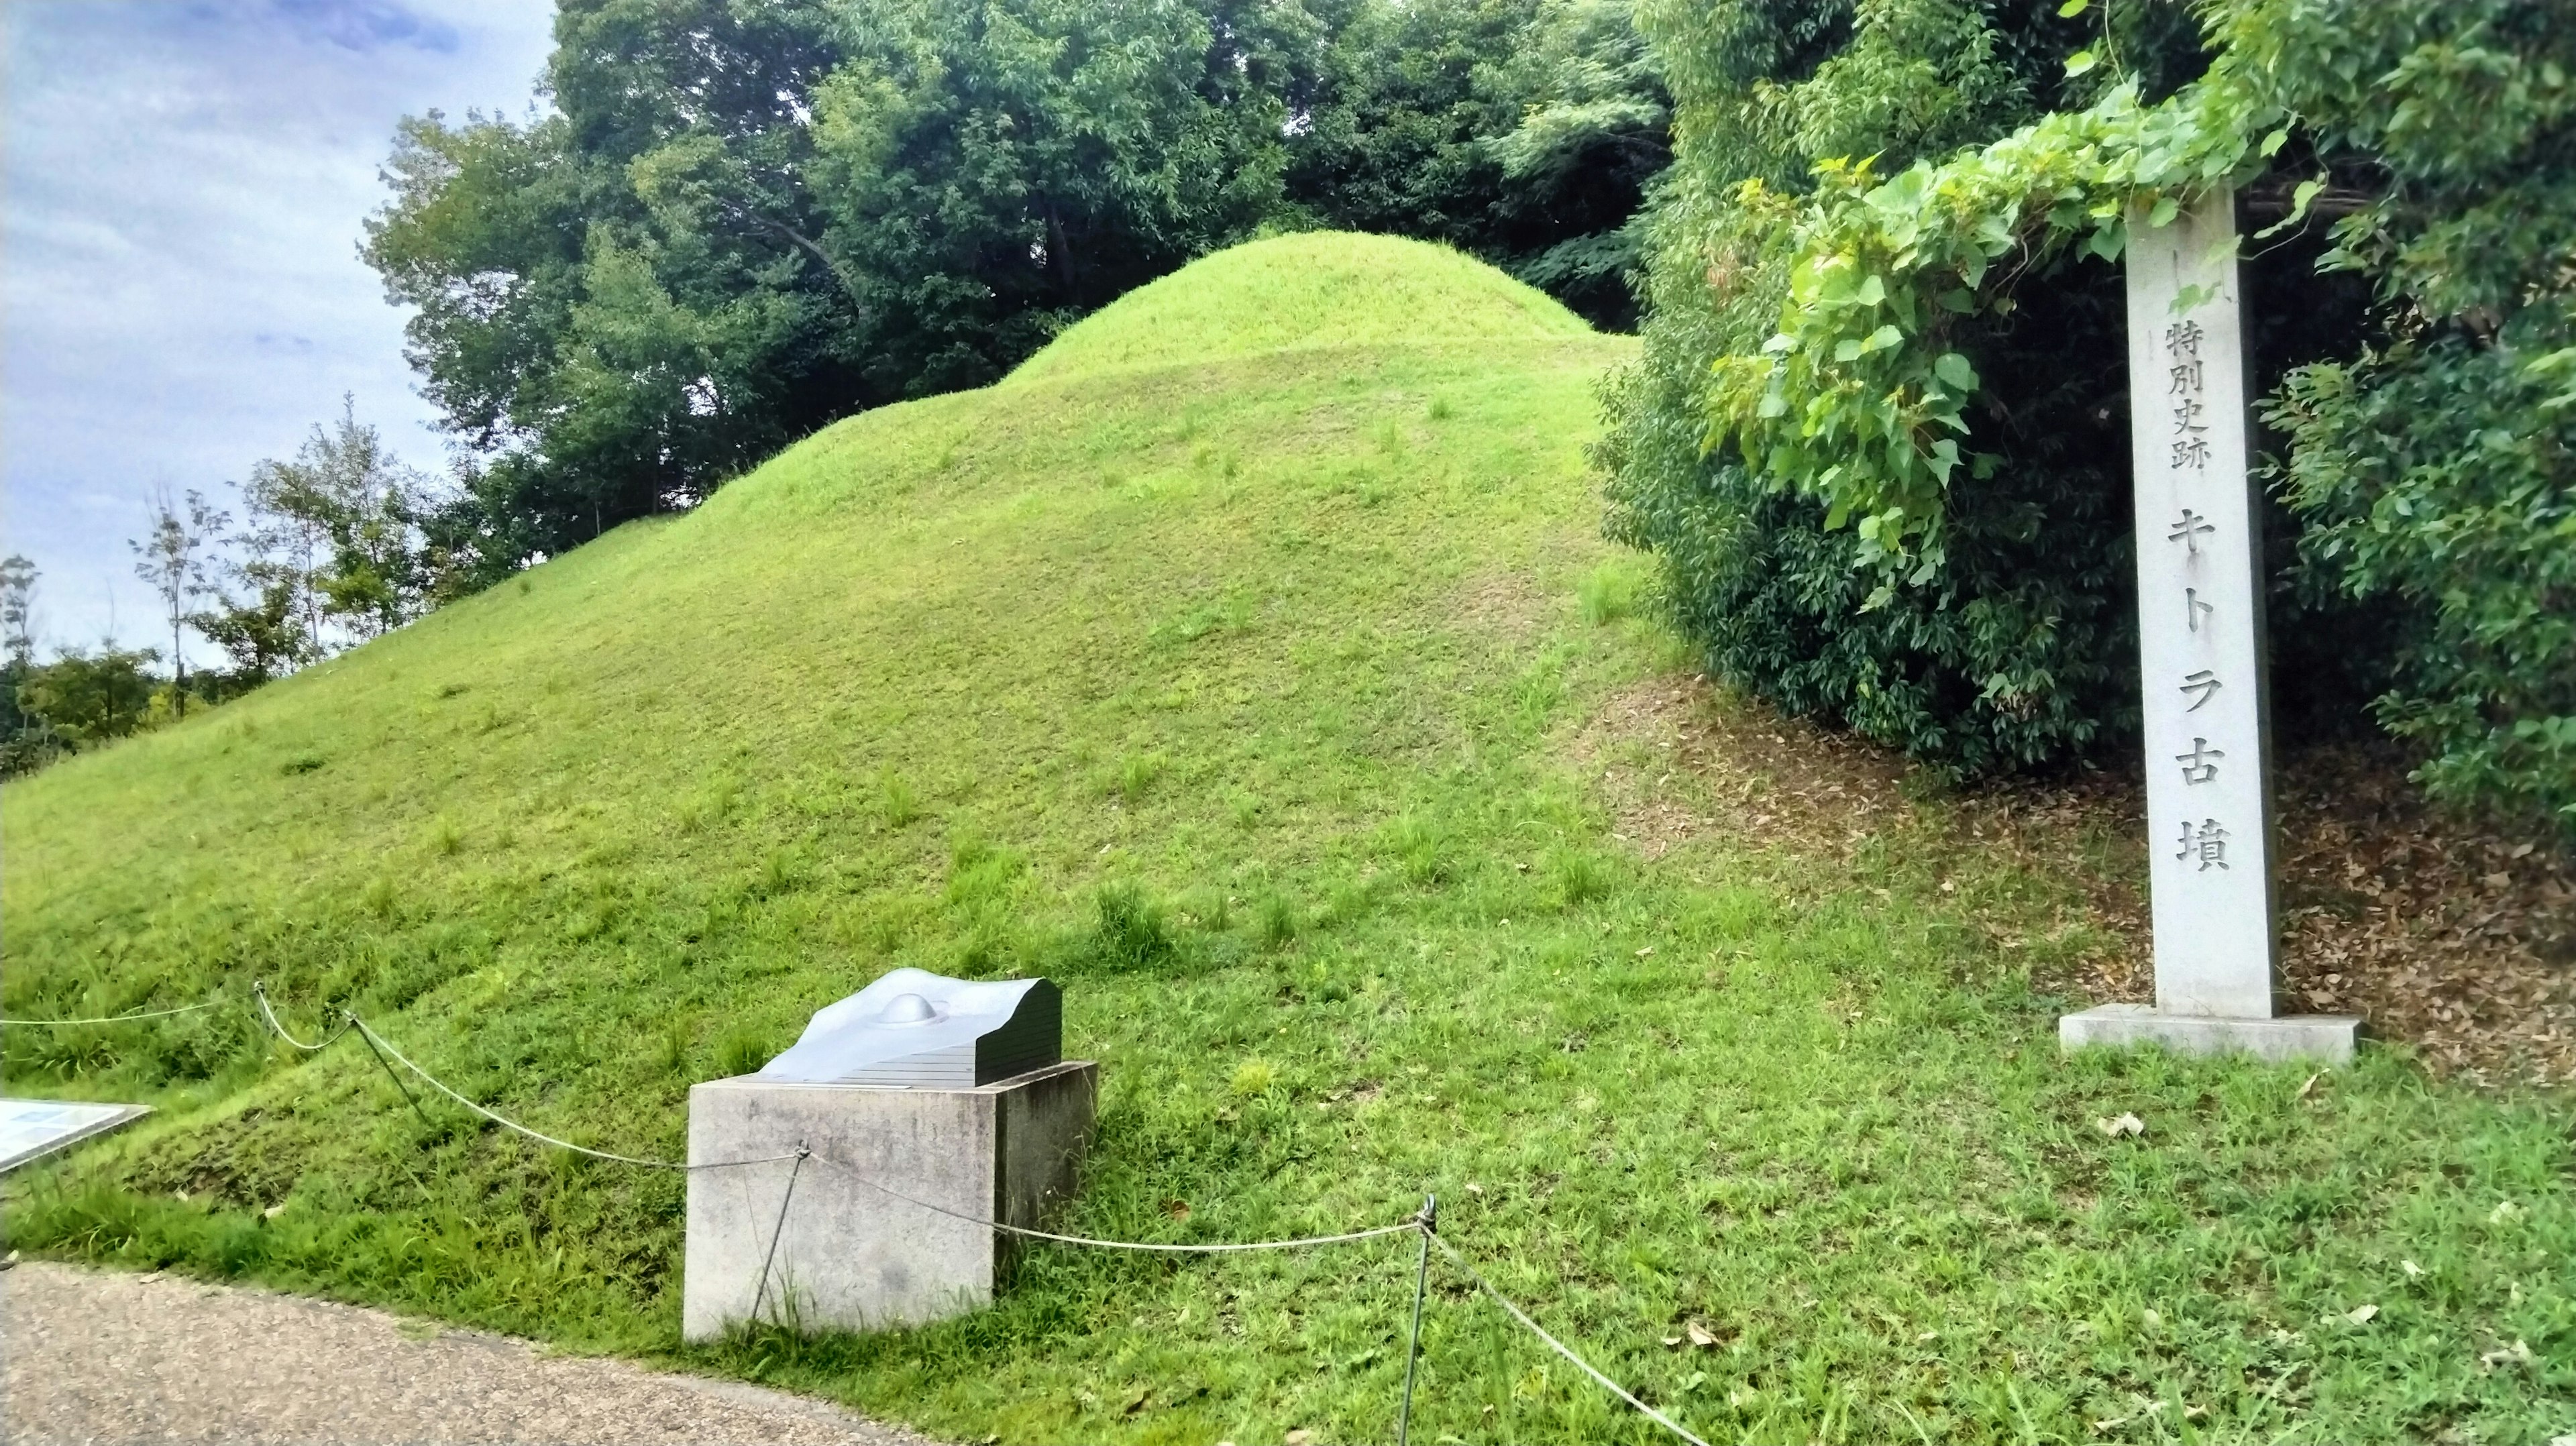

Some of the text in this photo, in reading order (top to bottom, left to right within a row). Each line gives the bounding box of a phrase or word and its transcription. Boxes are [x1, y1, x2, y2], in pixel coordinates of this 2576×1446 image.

[2165, 320, 2231, 872] 特別史跡 キトラ古墳
